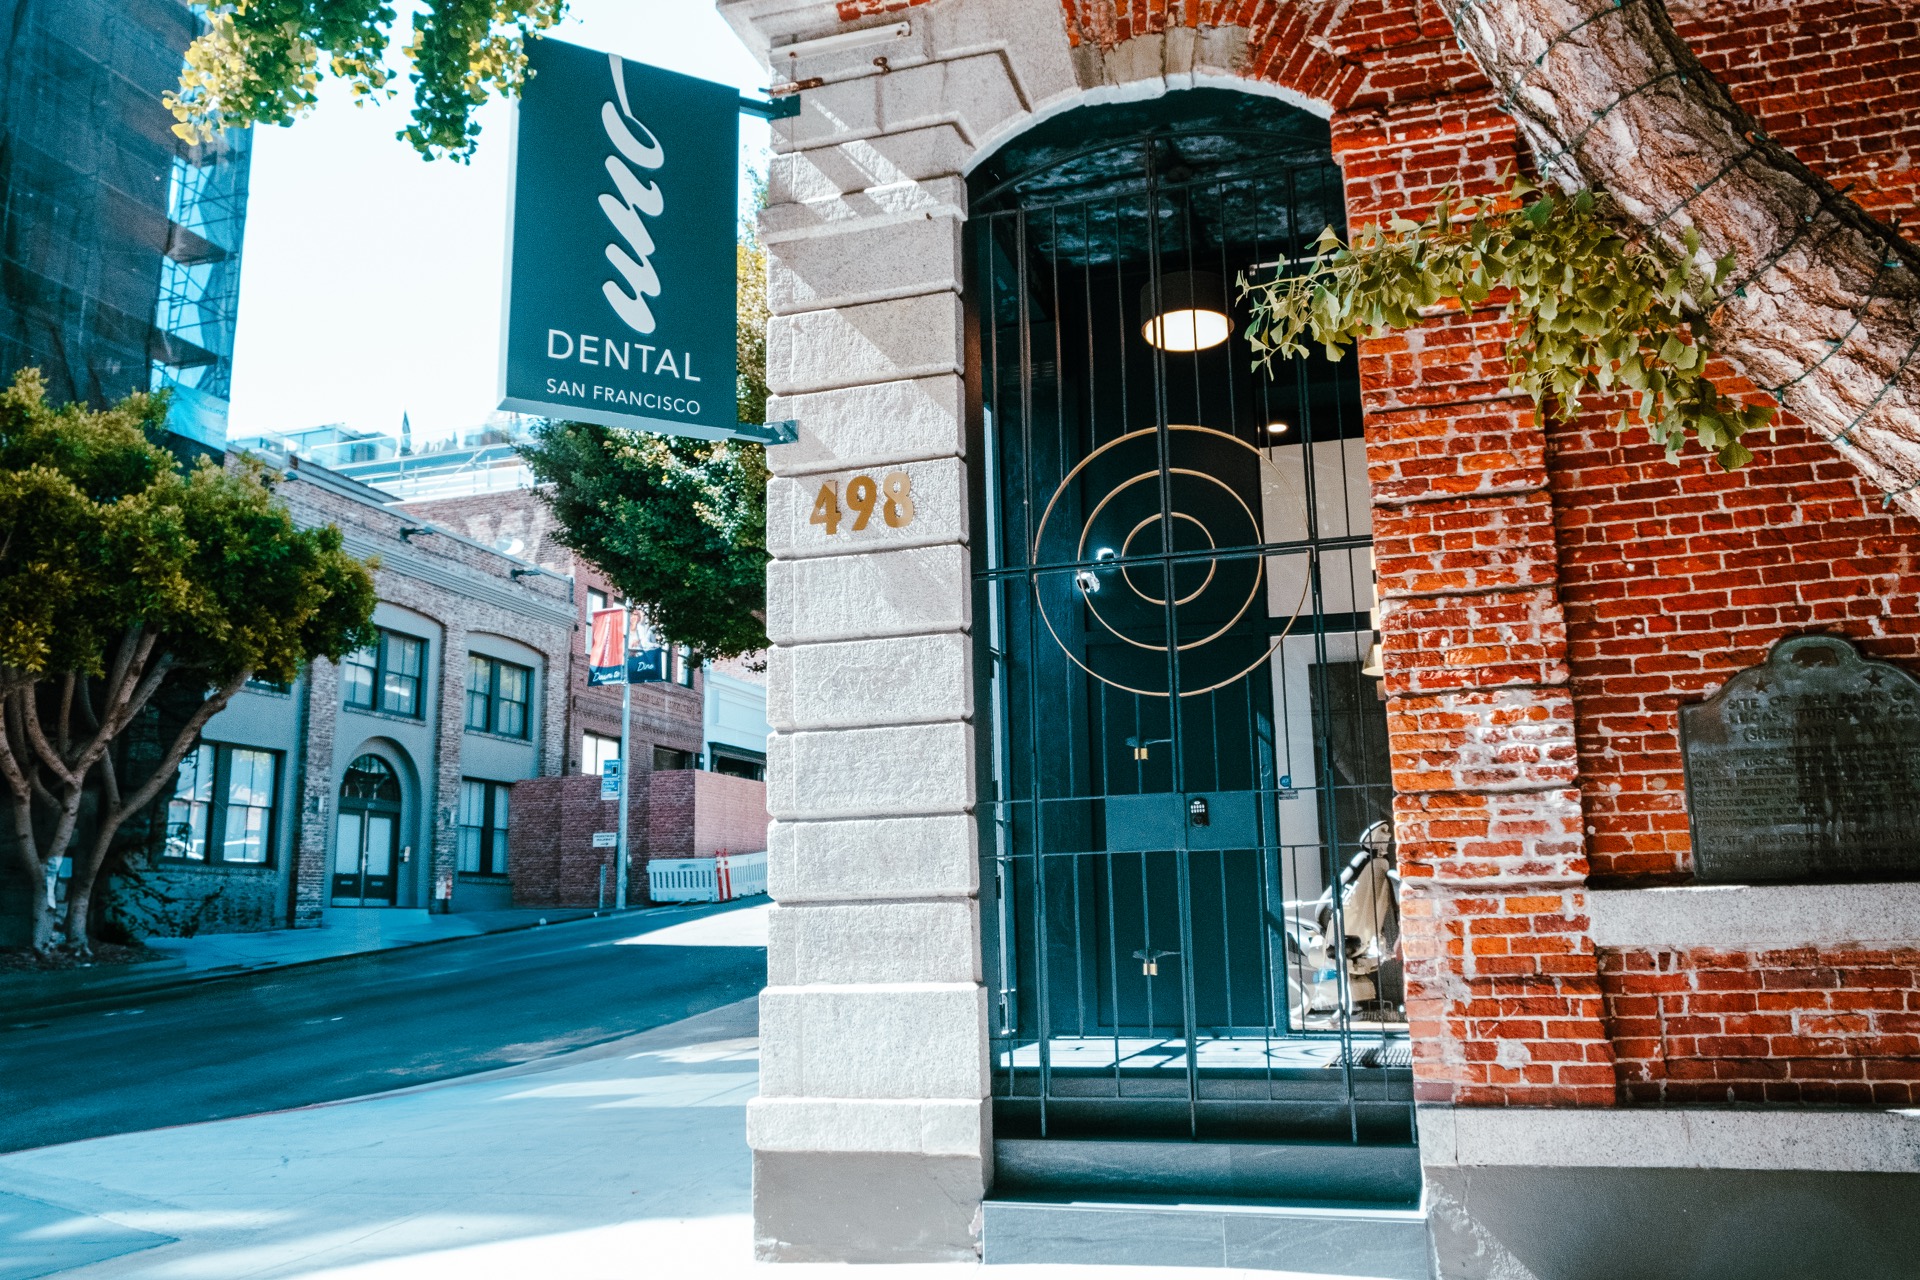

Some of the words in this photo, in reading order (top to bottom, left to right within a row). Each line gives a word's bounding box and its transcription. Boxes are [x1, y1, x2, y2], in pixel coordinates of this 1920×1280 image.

[547, 328, 701, 382] DENTAL
[546, 378, 586, 398] SAN
[593, 385, 701, 415] FRANCISCO
[809, 471, 914, 535] 498
[1727, 698, 1760, 710] SITE
[1768, 695, 1790, 707] OF
